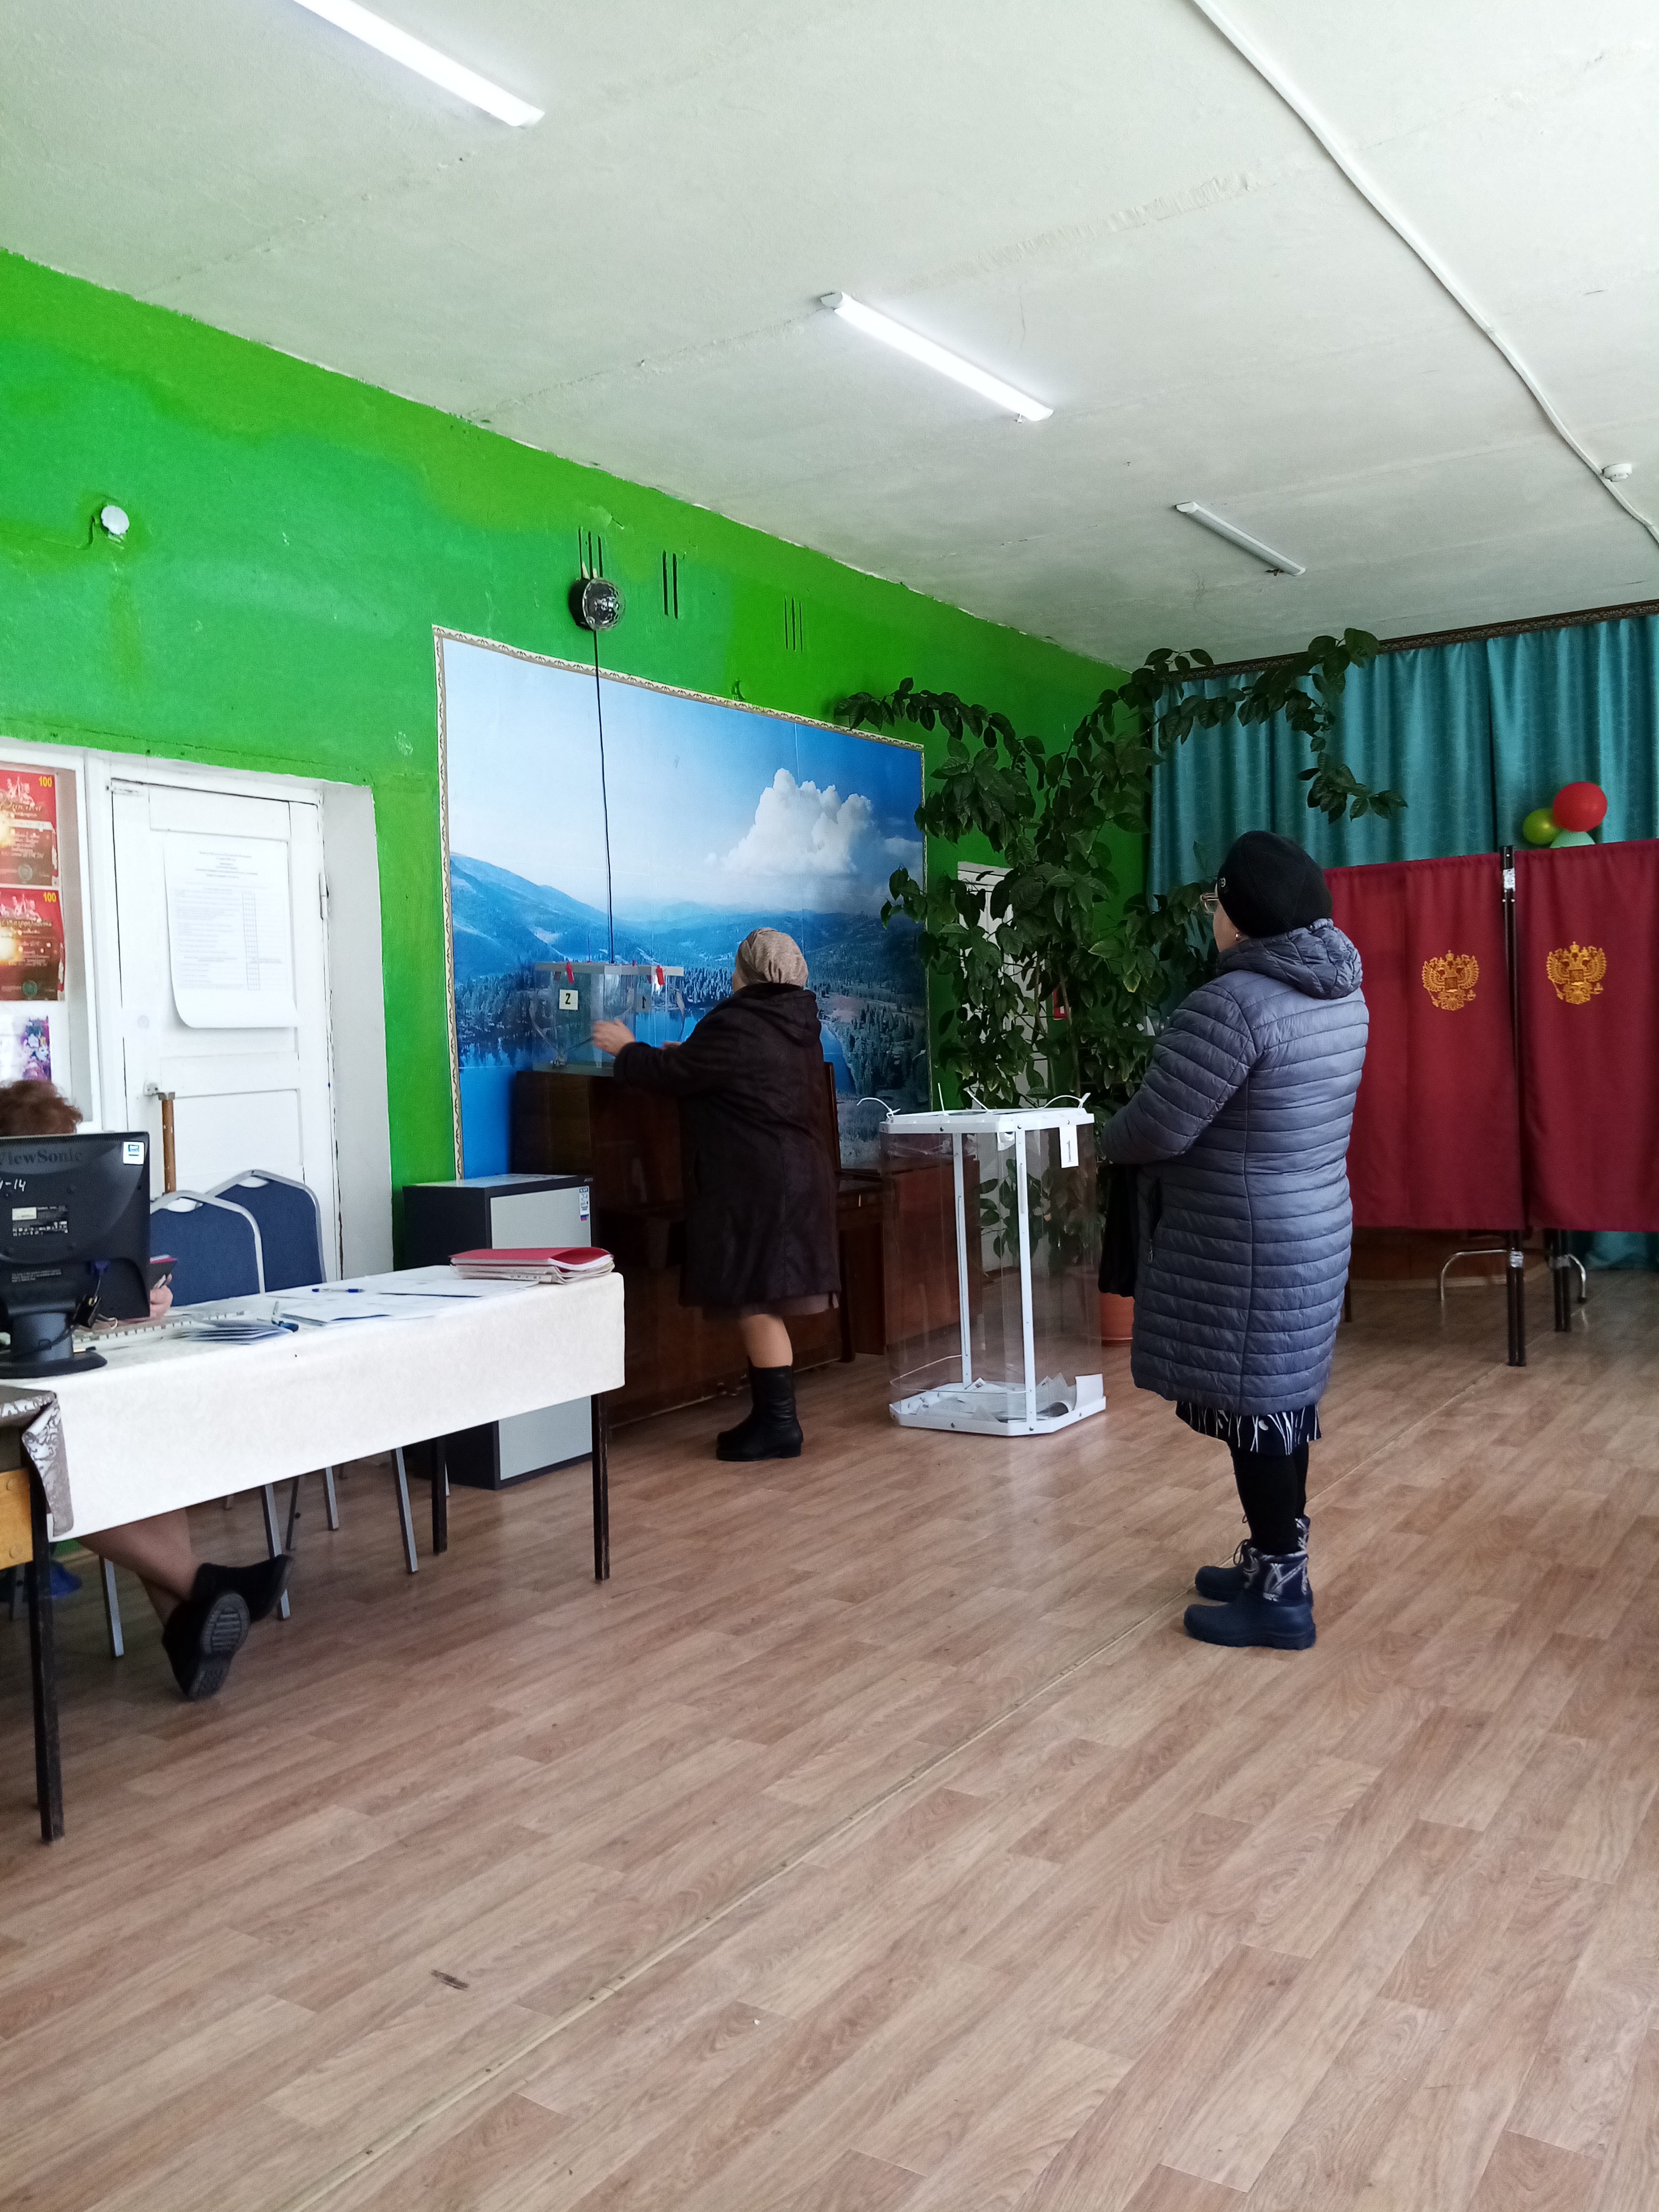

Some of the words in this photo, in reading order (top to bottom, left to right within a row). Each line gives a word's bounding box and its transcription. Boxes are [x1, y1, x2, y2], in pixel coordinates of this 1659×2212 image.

[39, 776, 53, 787] 100
[43, 892, 56, 903] 100
[565, 993, 571, 1005] 2
[1066, 1140, 1073, 1163] 1
